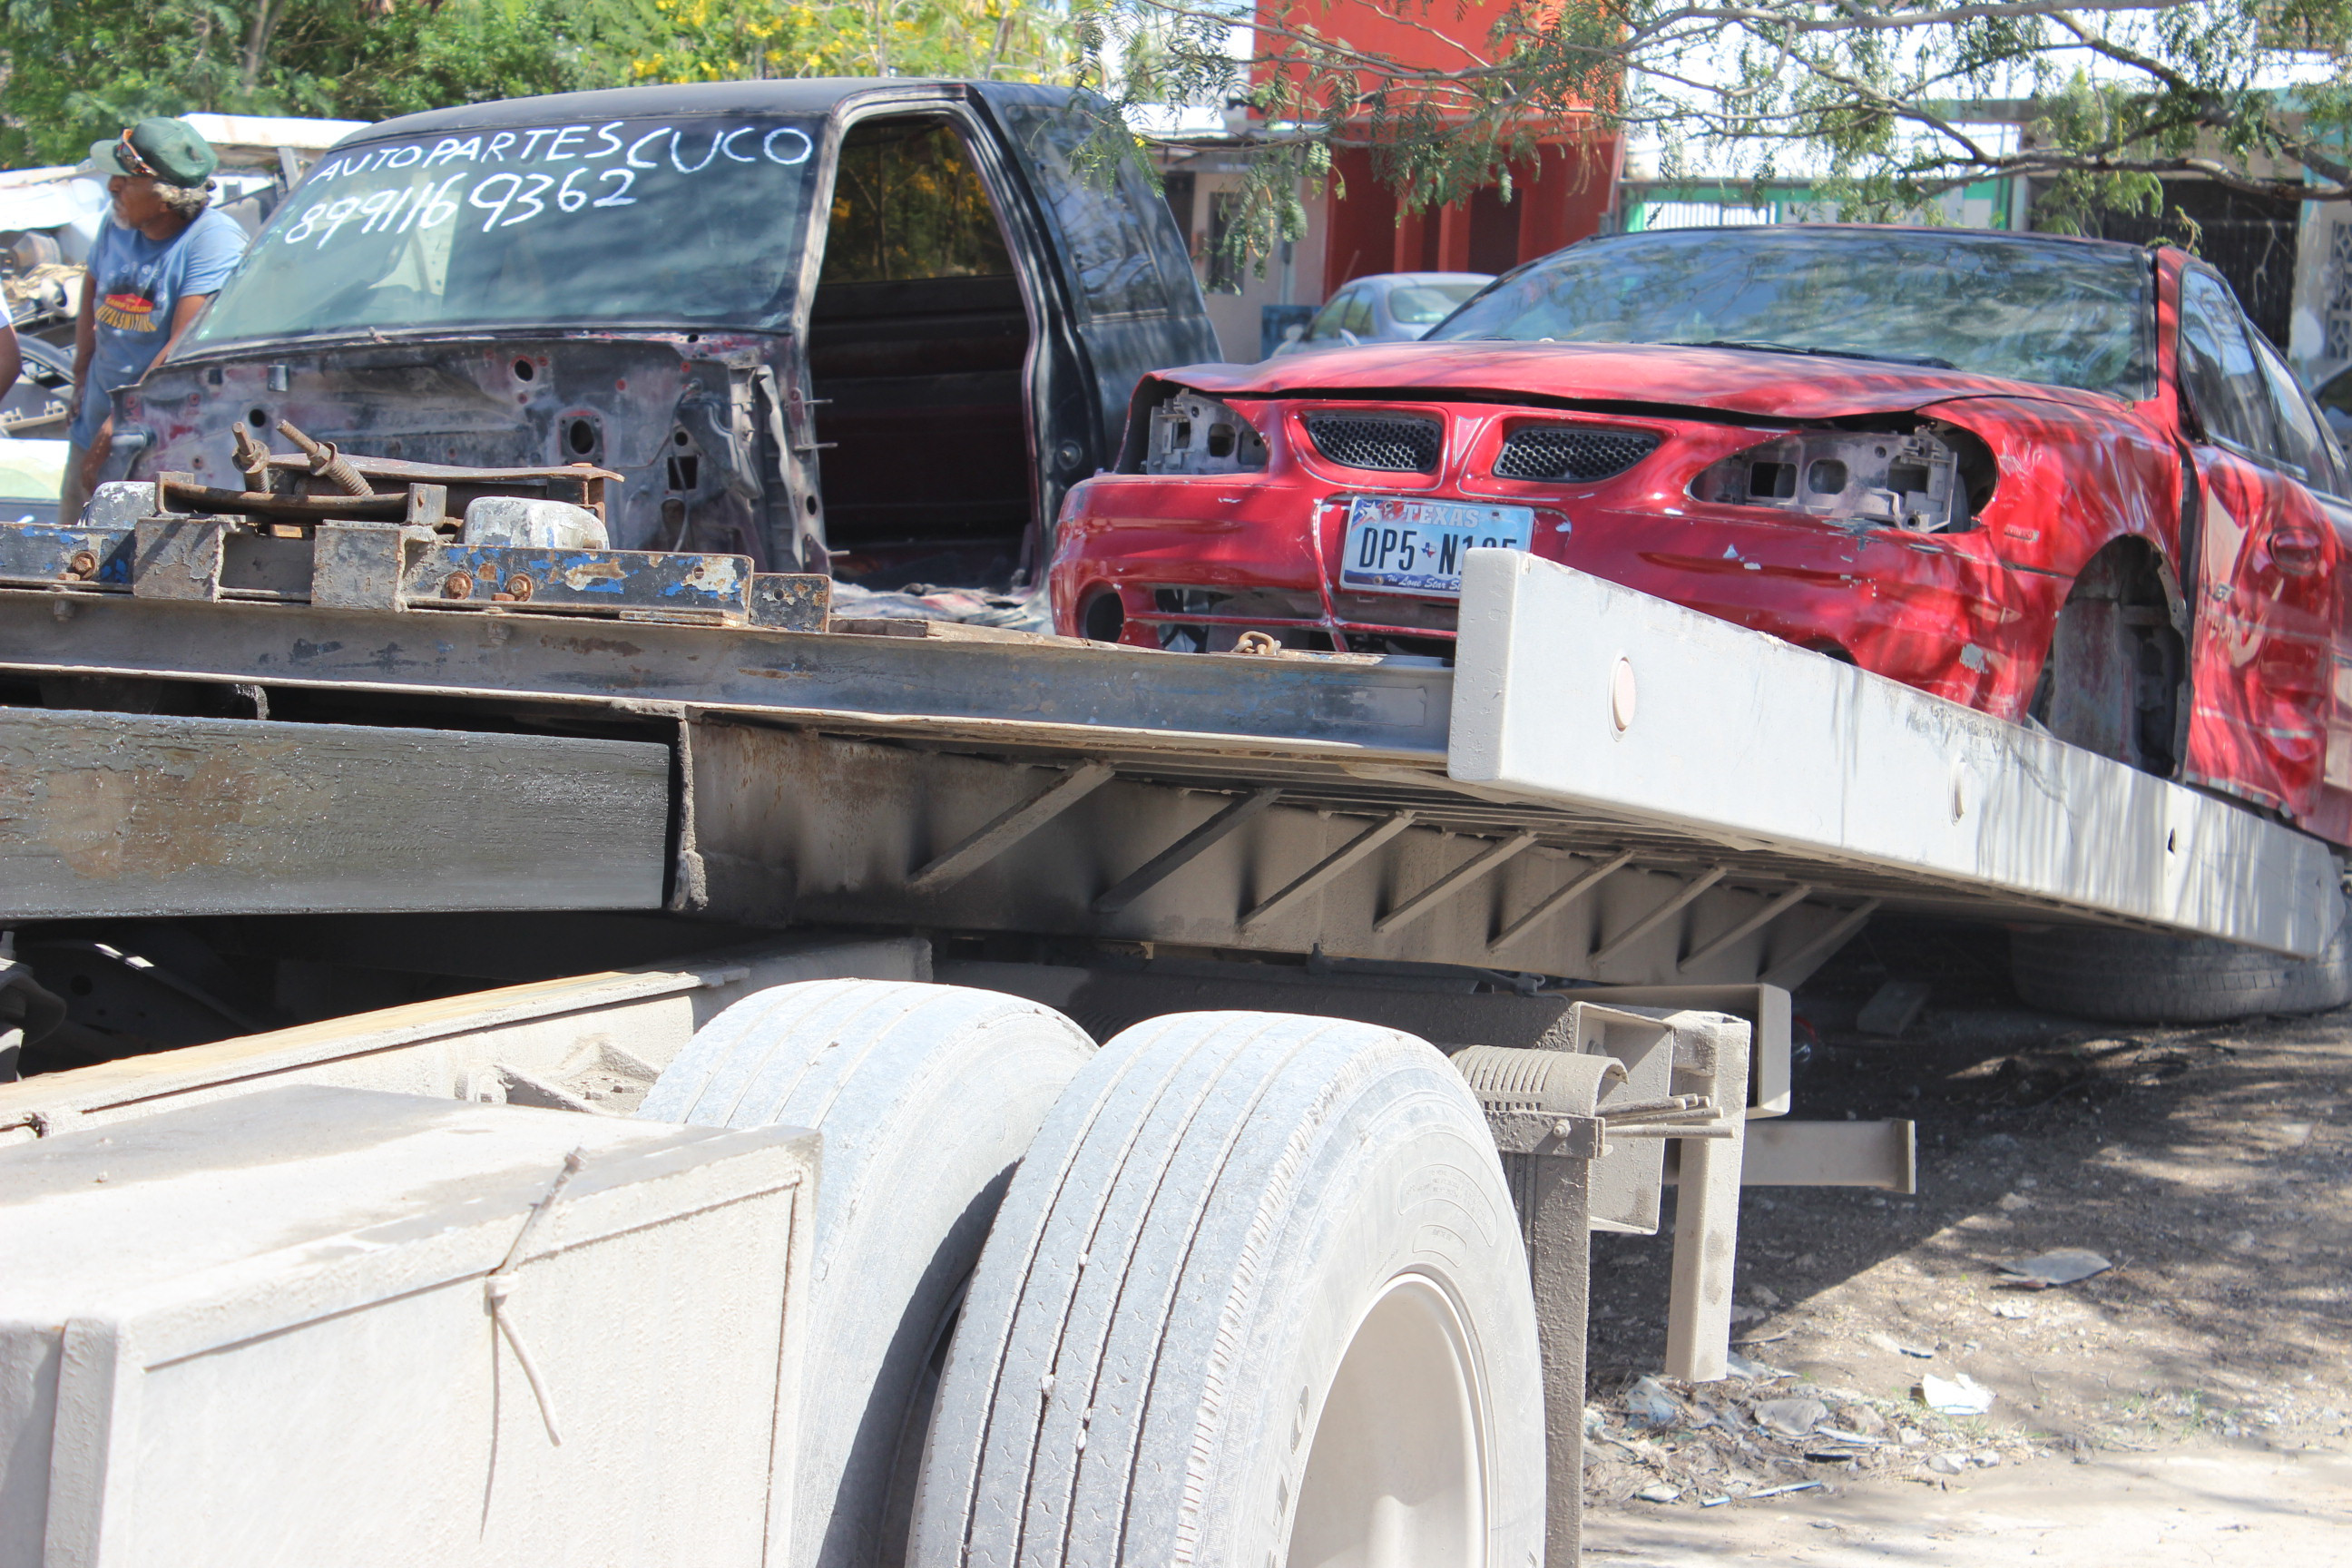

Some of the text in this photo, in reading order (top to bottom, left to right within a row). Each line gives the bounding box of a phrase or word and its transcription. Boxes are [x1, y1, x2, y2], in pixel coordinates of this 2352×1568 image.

[626, 126, 813, 173] CUCO
[1403, 504, 1480, 528] TEXAS
[1398, 574, 1422, 589] Lone
[1424, 578, 1446, 591] Star
